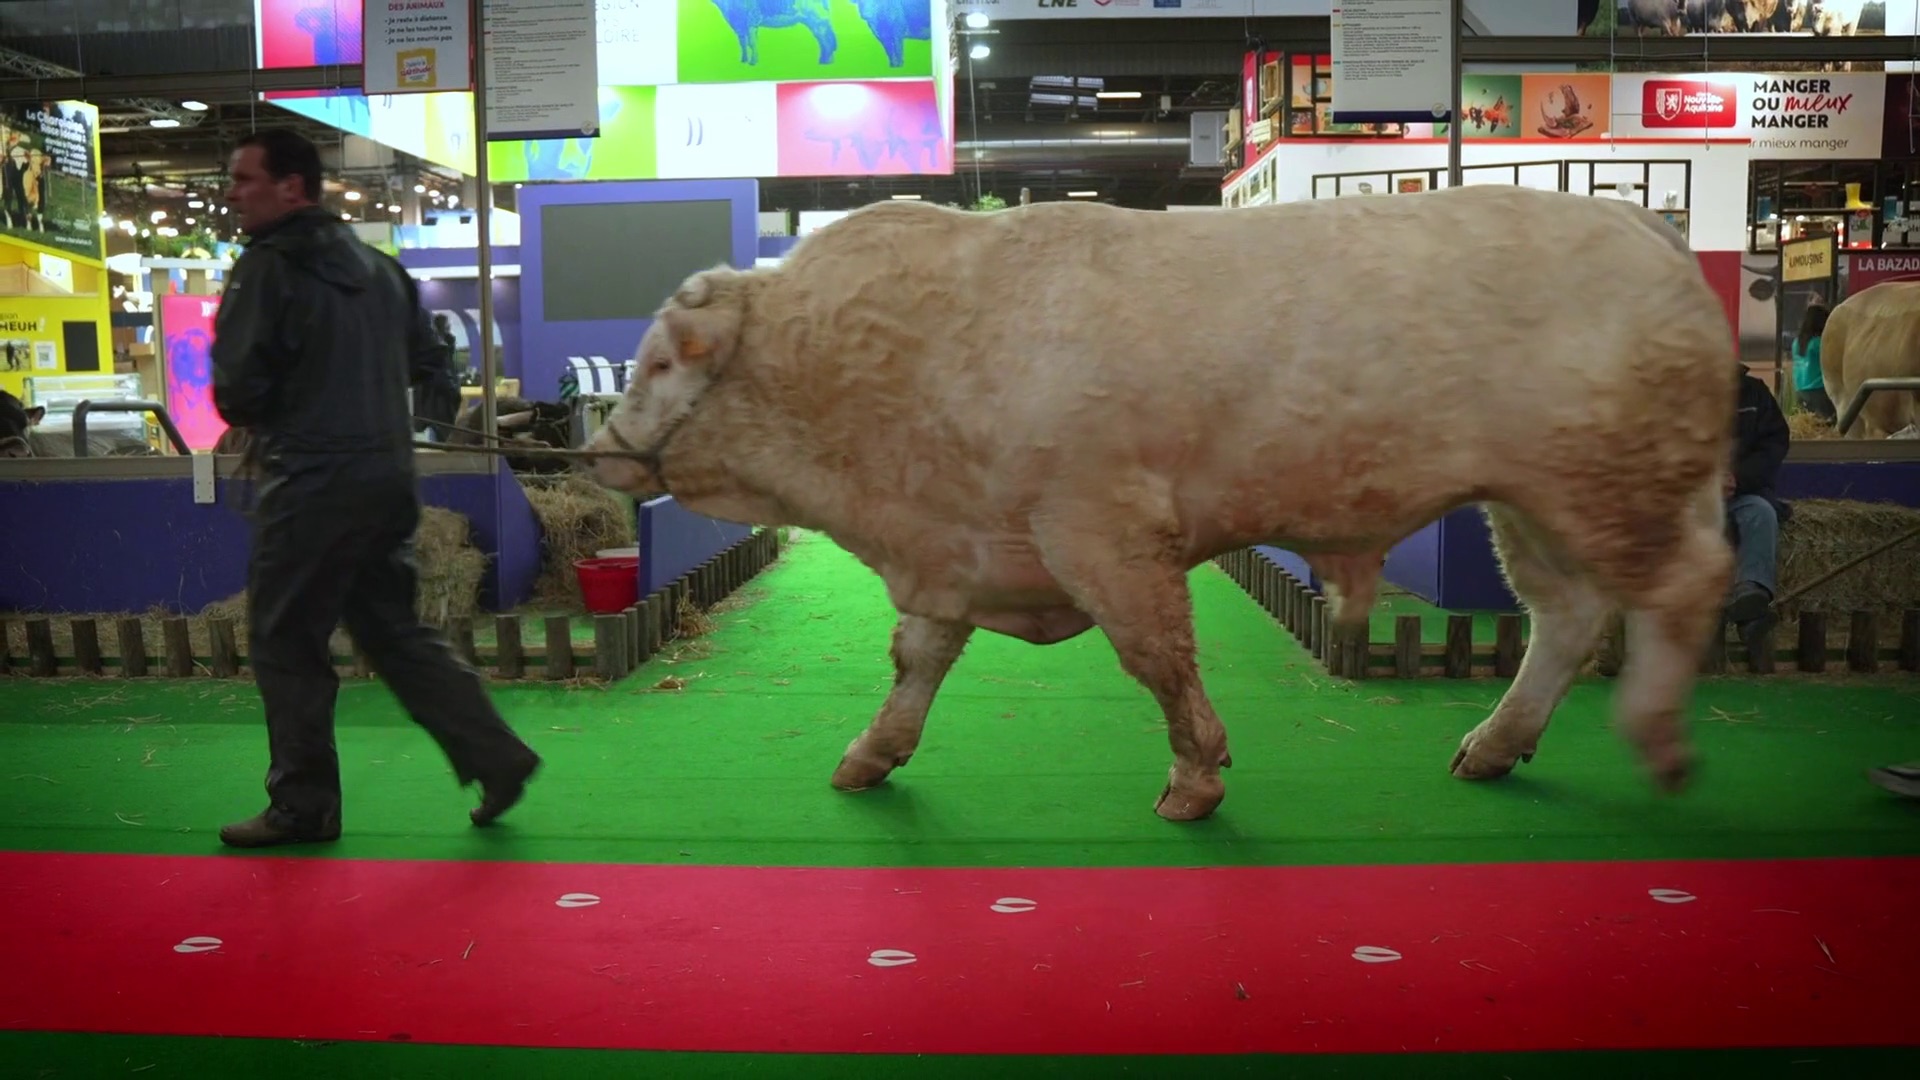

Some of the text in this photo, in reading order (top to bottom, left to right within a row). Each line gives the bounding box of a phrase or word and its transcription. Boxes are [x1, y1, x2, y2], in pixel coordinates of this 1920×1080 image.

[388, 1, 445, 11] DES ANIMAUX
[439, 25, 452, 33] pas
[440, 35, 452, 43] pas
[1753, 79, 1830, 94] MANGER
[1752, 93, 1853, 115] OU mieux
[1751, 114, 1829, 128] MANGER
[1759, 138, 1796, 148] mieux
[1800, 138, 1849, 151] manger
[1788, 251, 1824, 268] LIMOUSINE
[1858, 258, 1875, 271] LA
